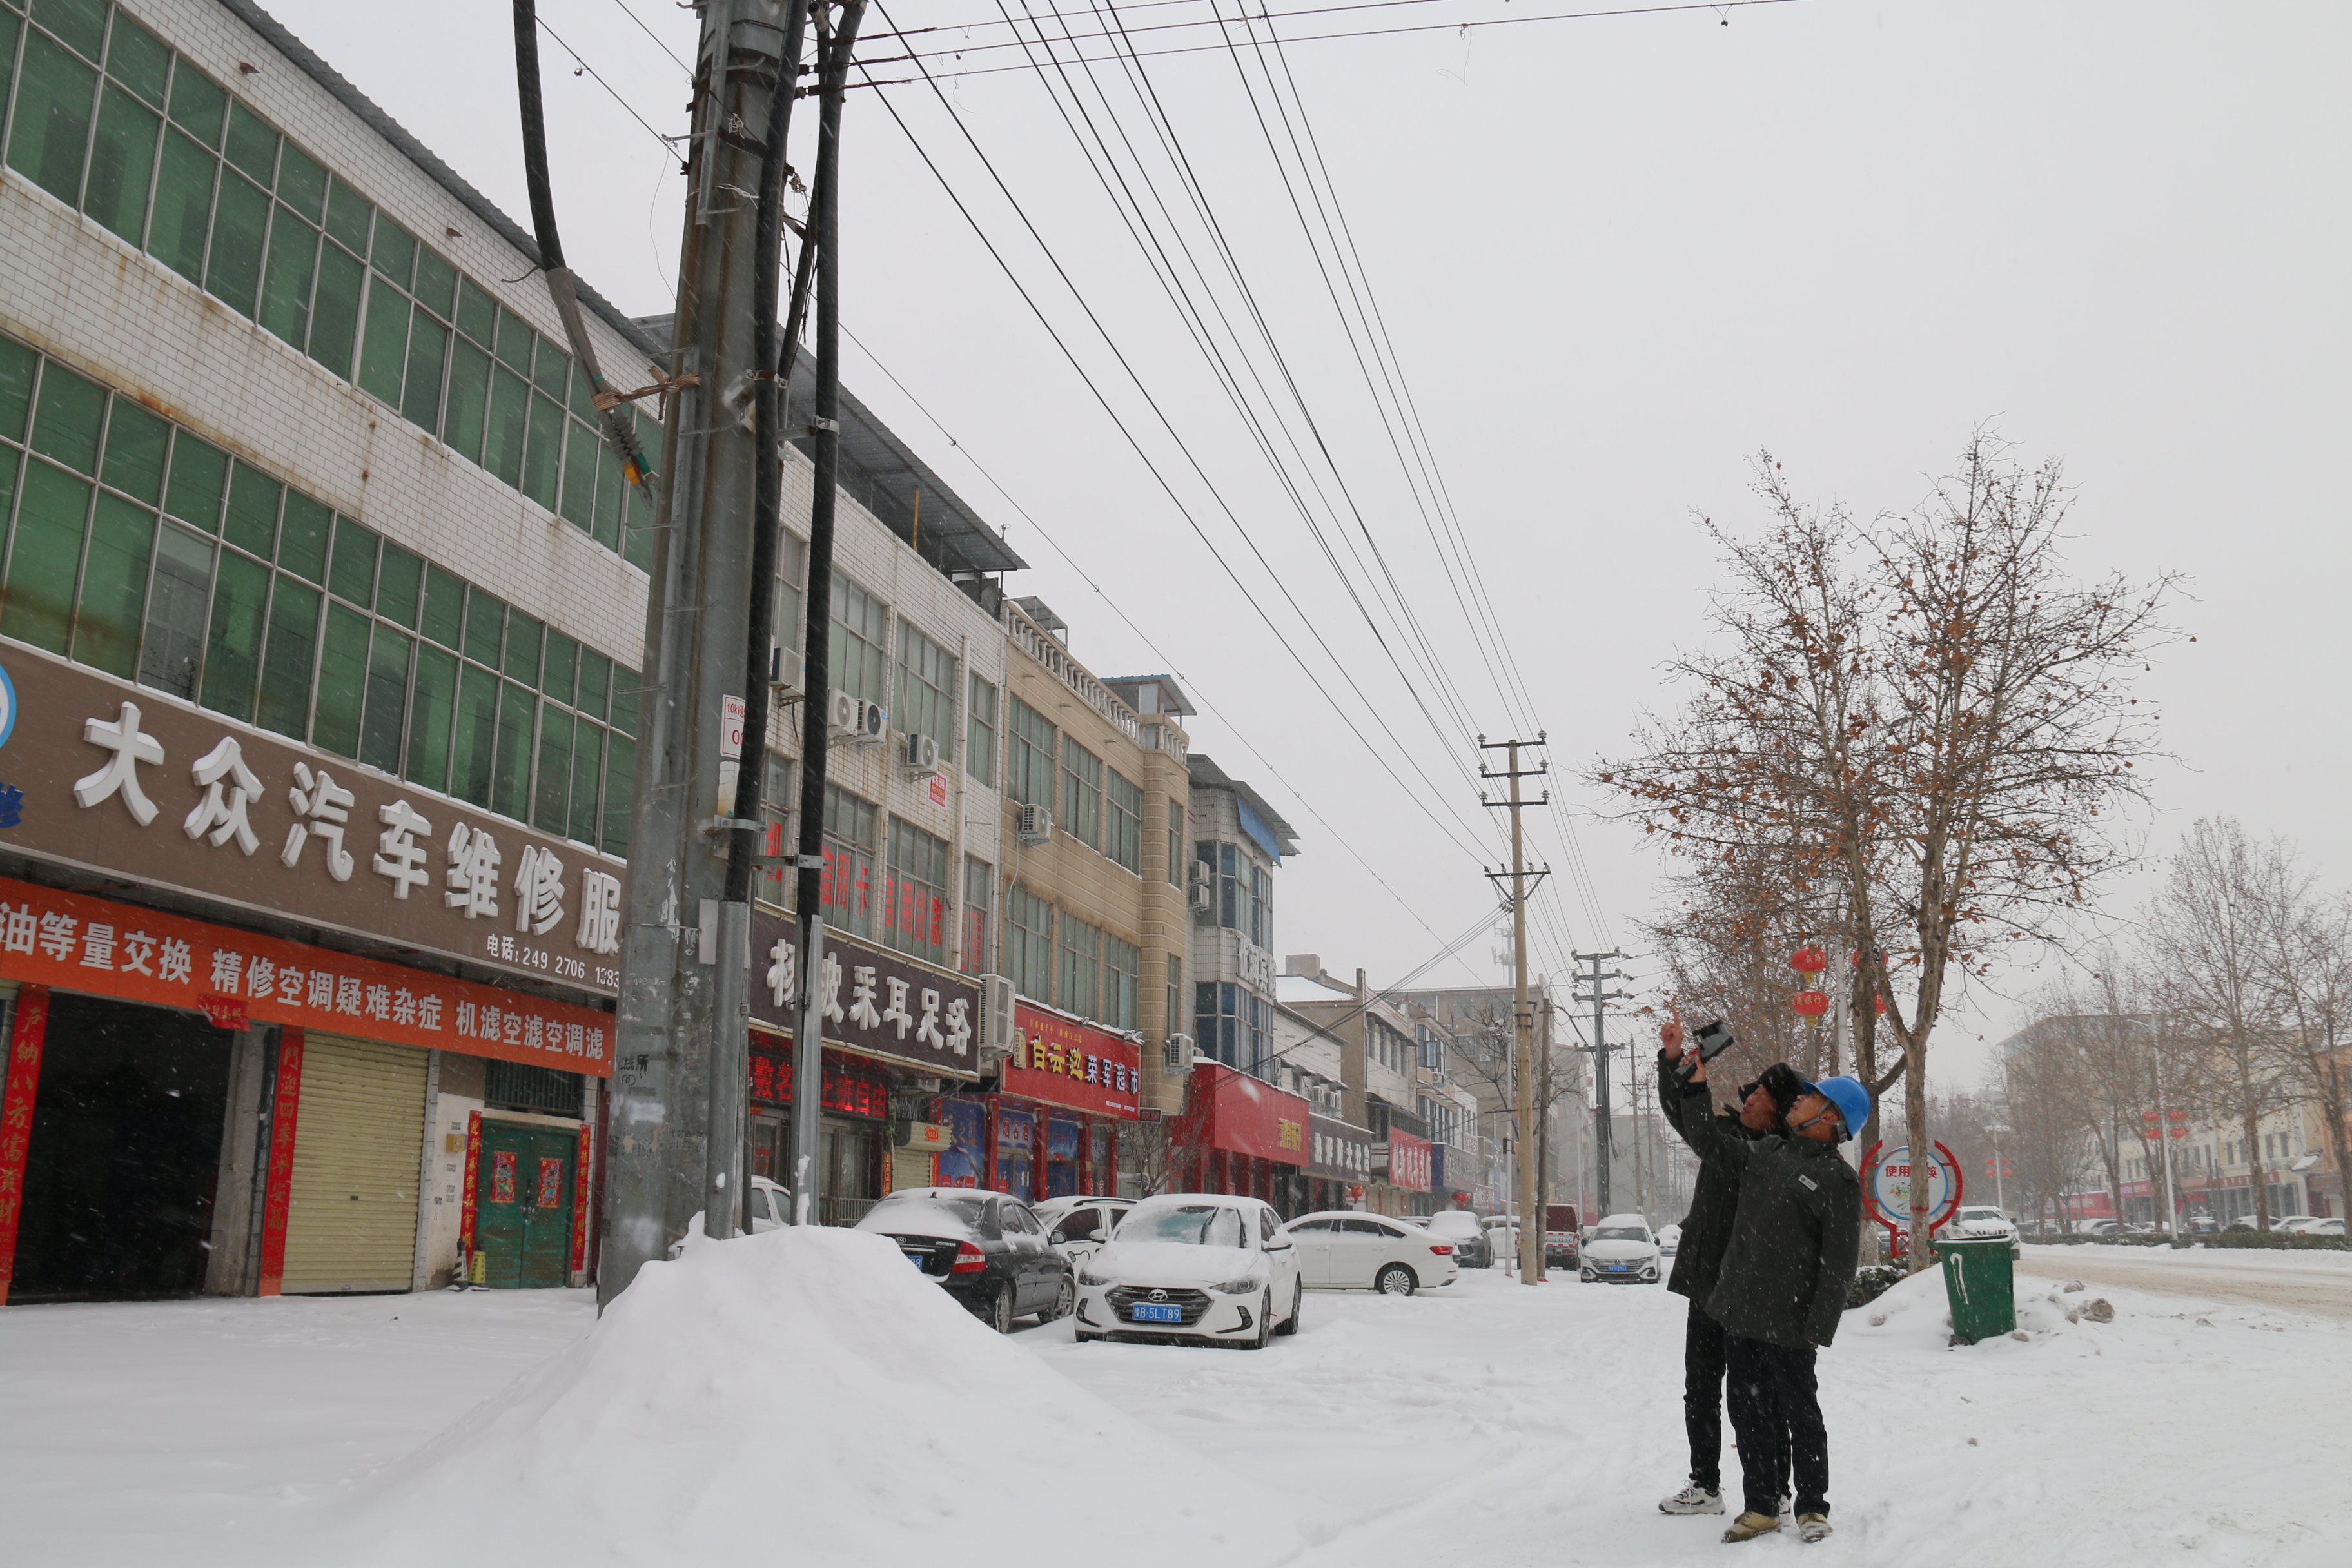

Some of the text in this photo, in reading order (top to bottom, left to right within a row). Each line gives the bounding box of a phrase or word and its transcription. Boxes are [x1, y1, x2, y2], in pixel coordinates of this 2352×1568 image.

[74, 701, 621, 956] 大众汽车维修服
[555, 956, 585, 979] 2706
[210, 949, 442, 1030] 精修空调疑难杂症
[456, 1000, 603, 1060] 机滤空滤空调滤
[1885, 1165, 1937, 1179] 使用筷
